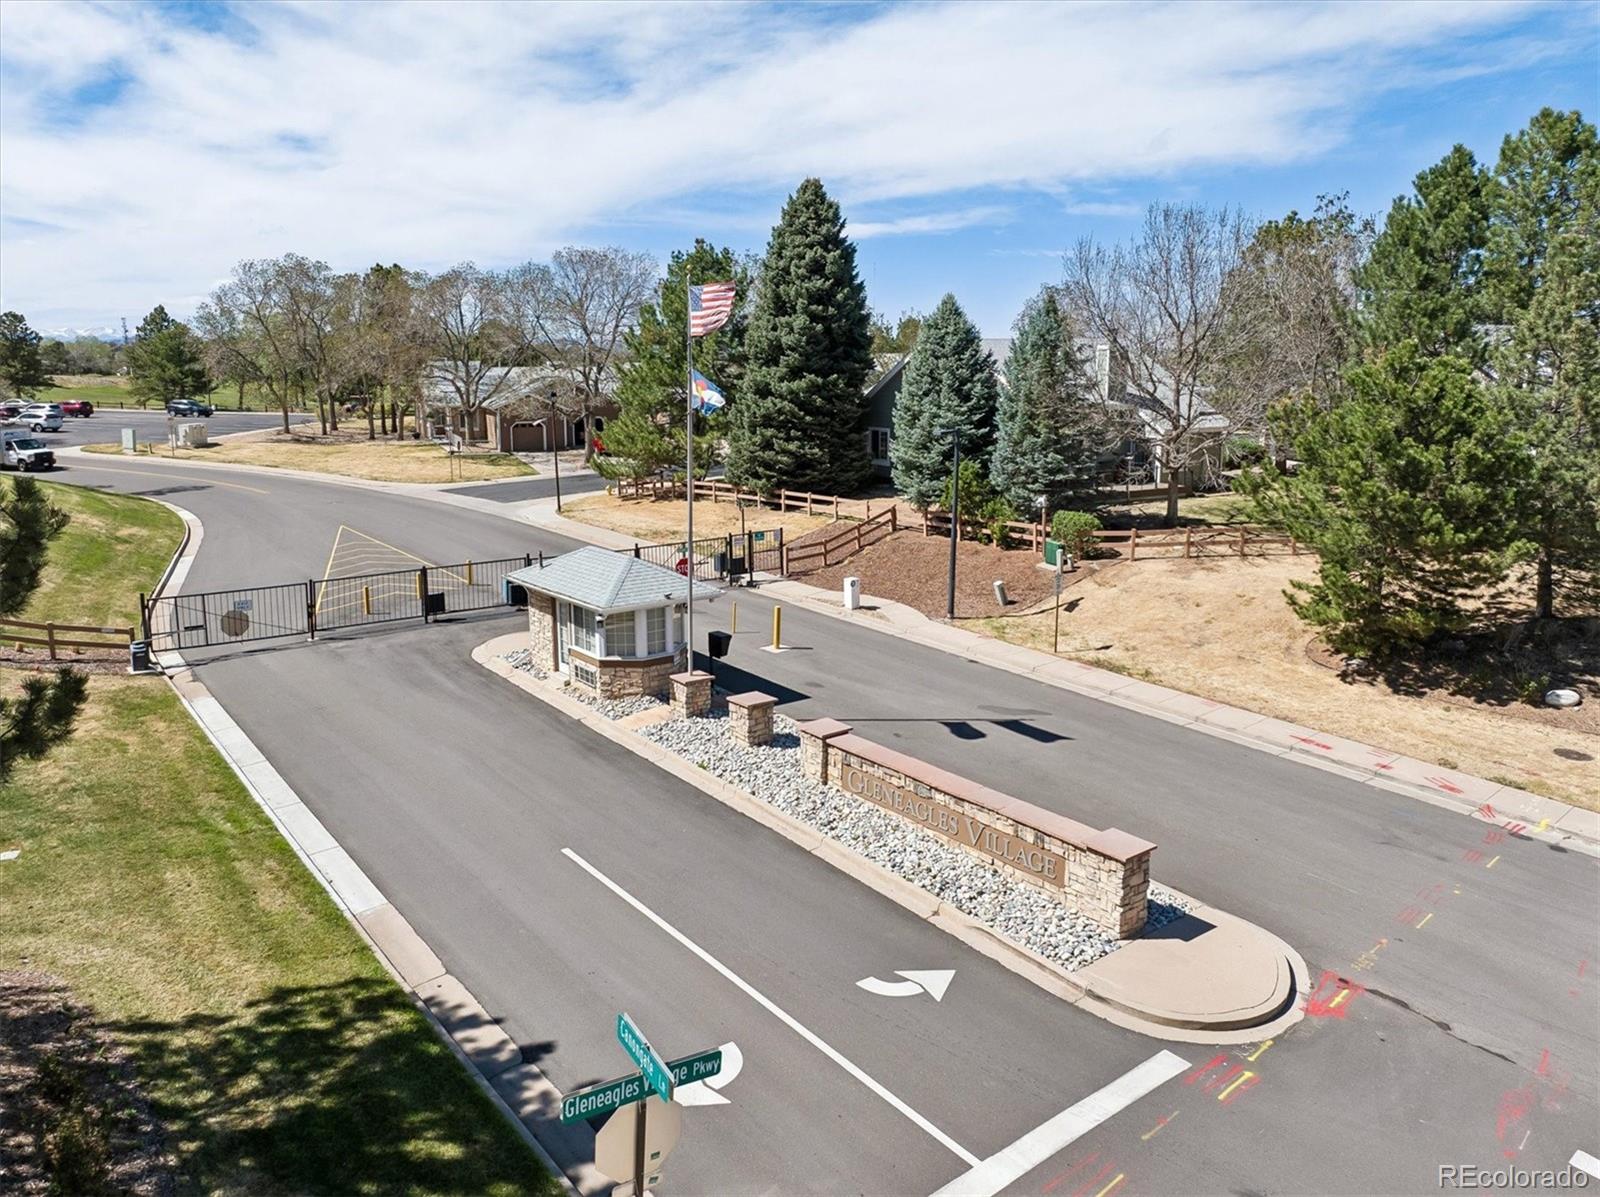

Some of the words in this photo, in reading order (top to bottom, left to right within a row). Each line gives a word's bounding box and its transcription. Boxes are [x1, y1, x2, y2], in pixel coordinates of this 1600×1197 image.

[848, 769, 960, 837] GLENEAGLES
[966, 818, 1058, 880] VILLAGE
[565, 1081, 640, 1118] Gleneagles
[692, 1058, 720, 1076] Pkwy
